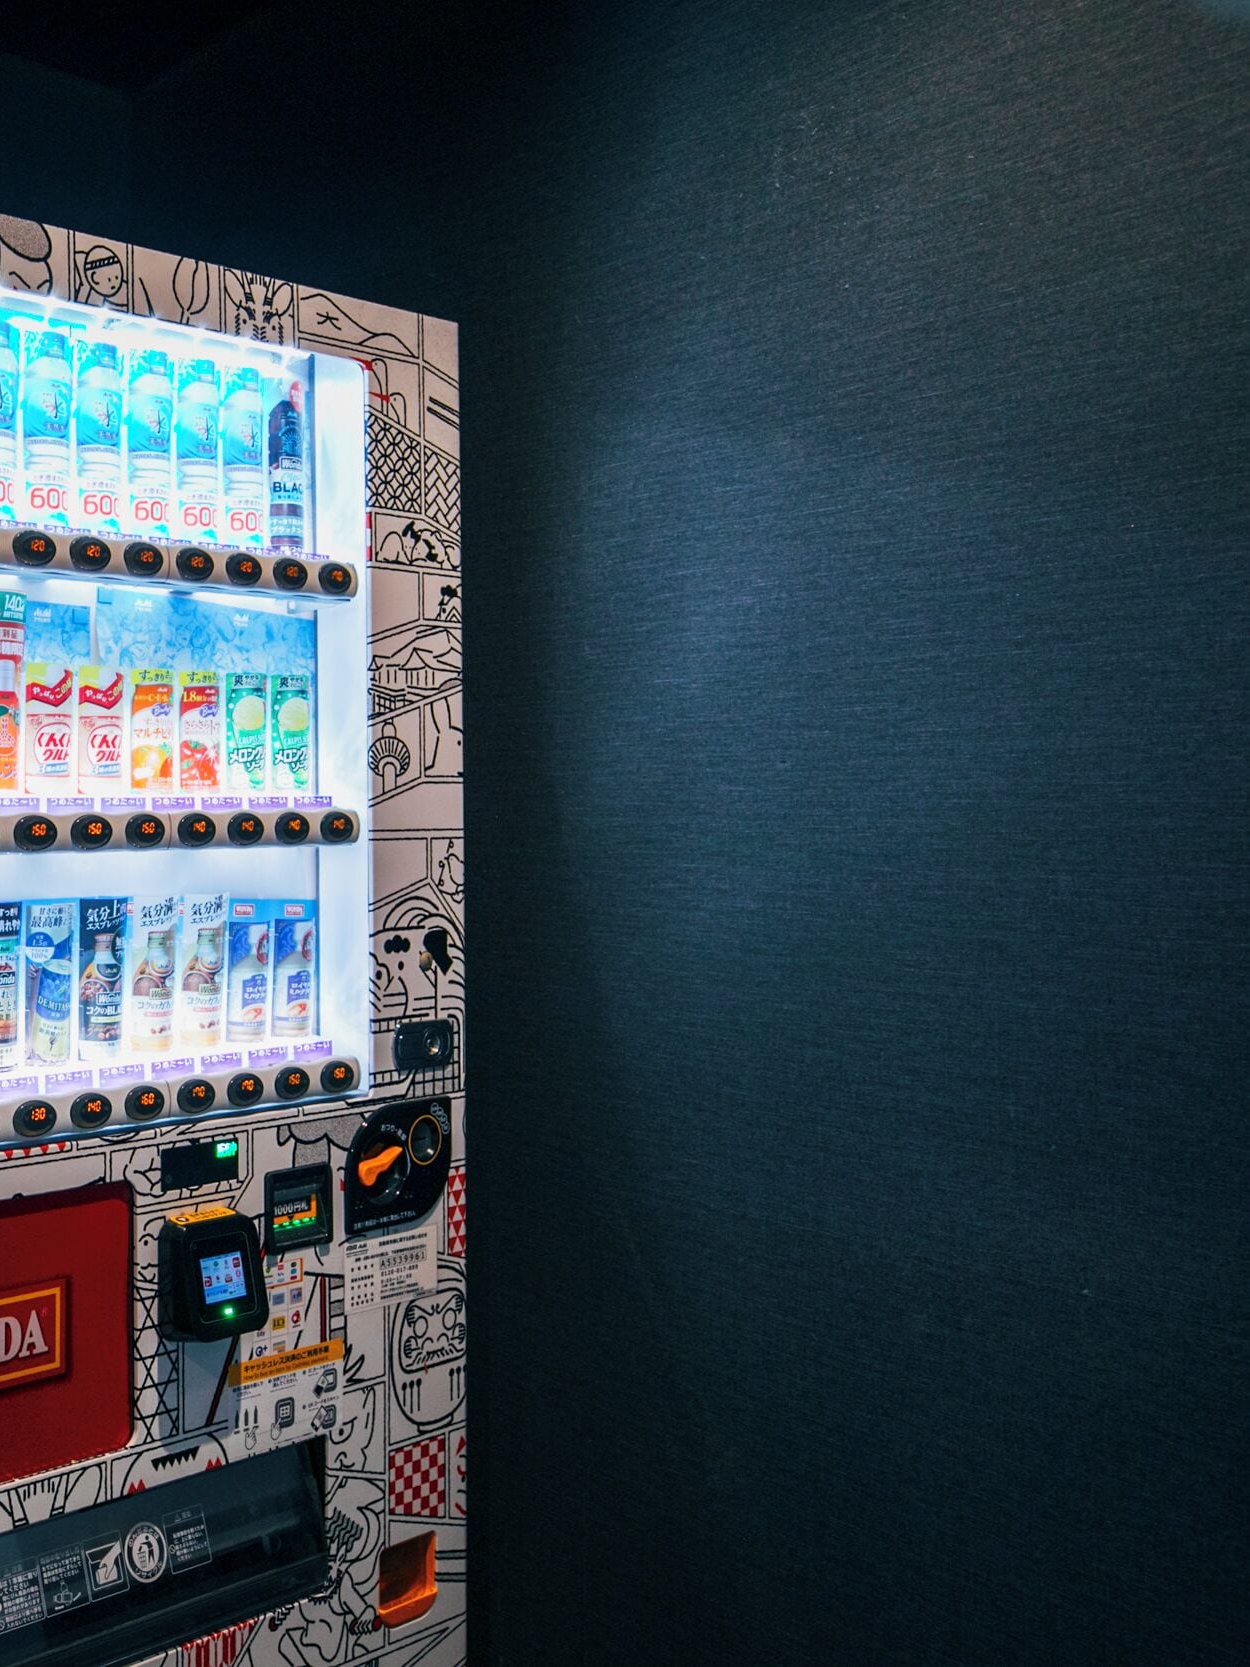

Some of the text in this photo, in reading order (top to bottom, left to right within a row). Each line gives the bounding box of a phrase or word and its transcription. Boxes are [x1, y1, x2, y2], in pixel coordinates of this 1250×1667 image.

[31, 823, 47, 837] 150
[87, 822, 102, 836] 150
[141, 822, 155, 835] 150
[141, 1093, 155, 1105] 160
[87, 1100, 102, 1112] 140
[31, 1107, 46, 1120] 130
[274, 1200, 309, 1216] 1000円札
